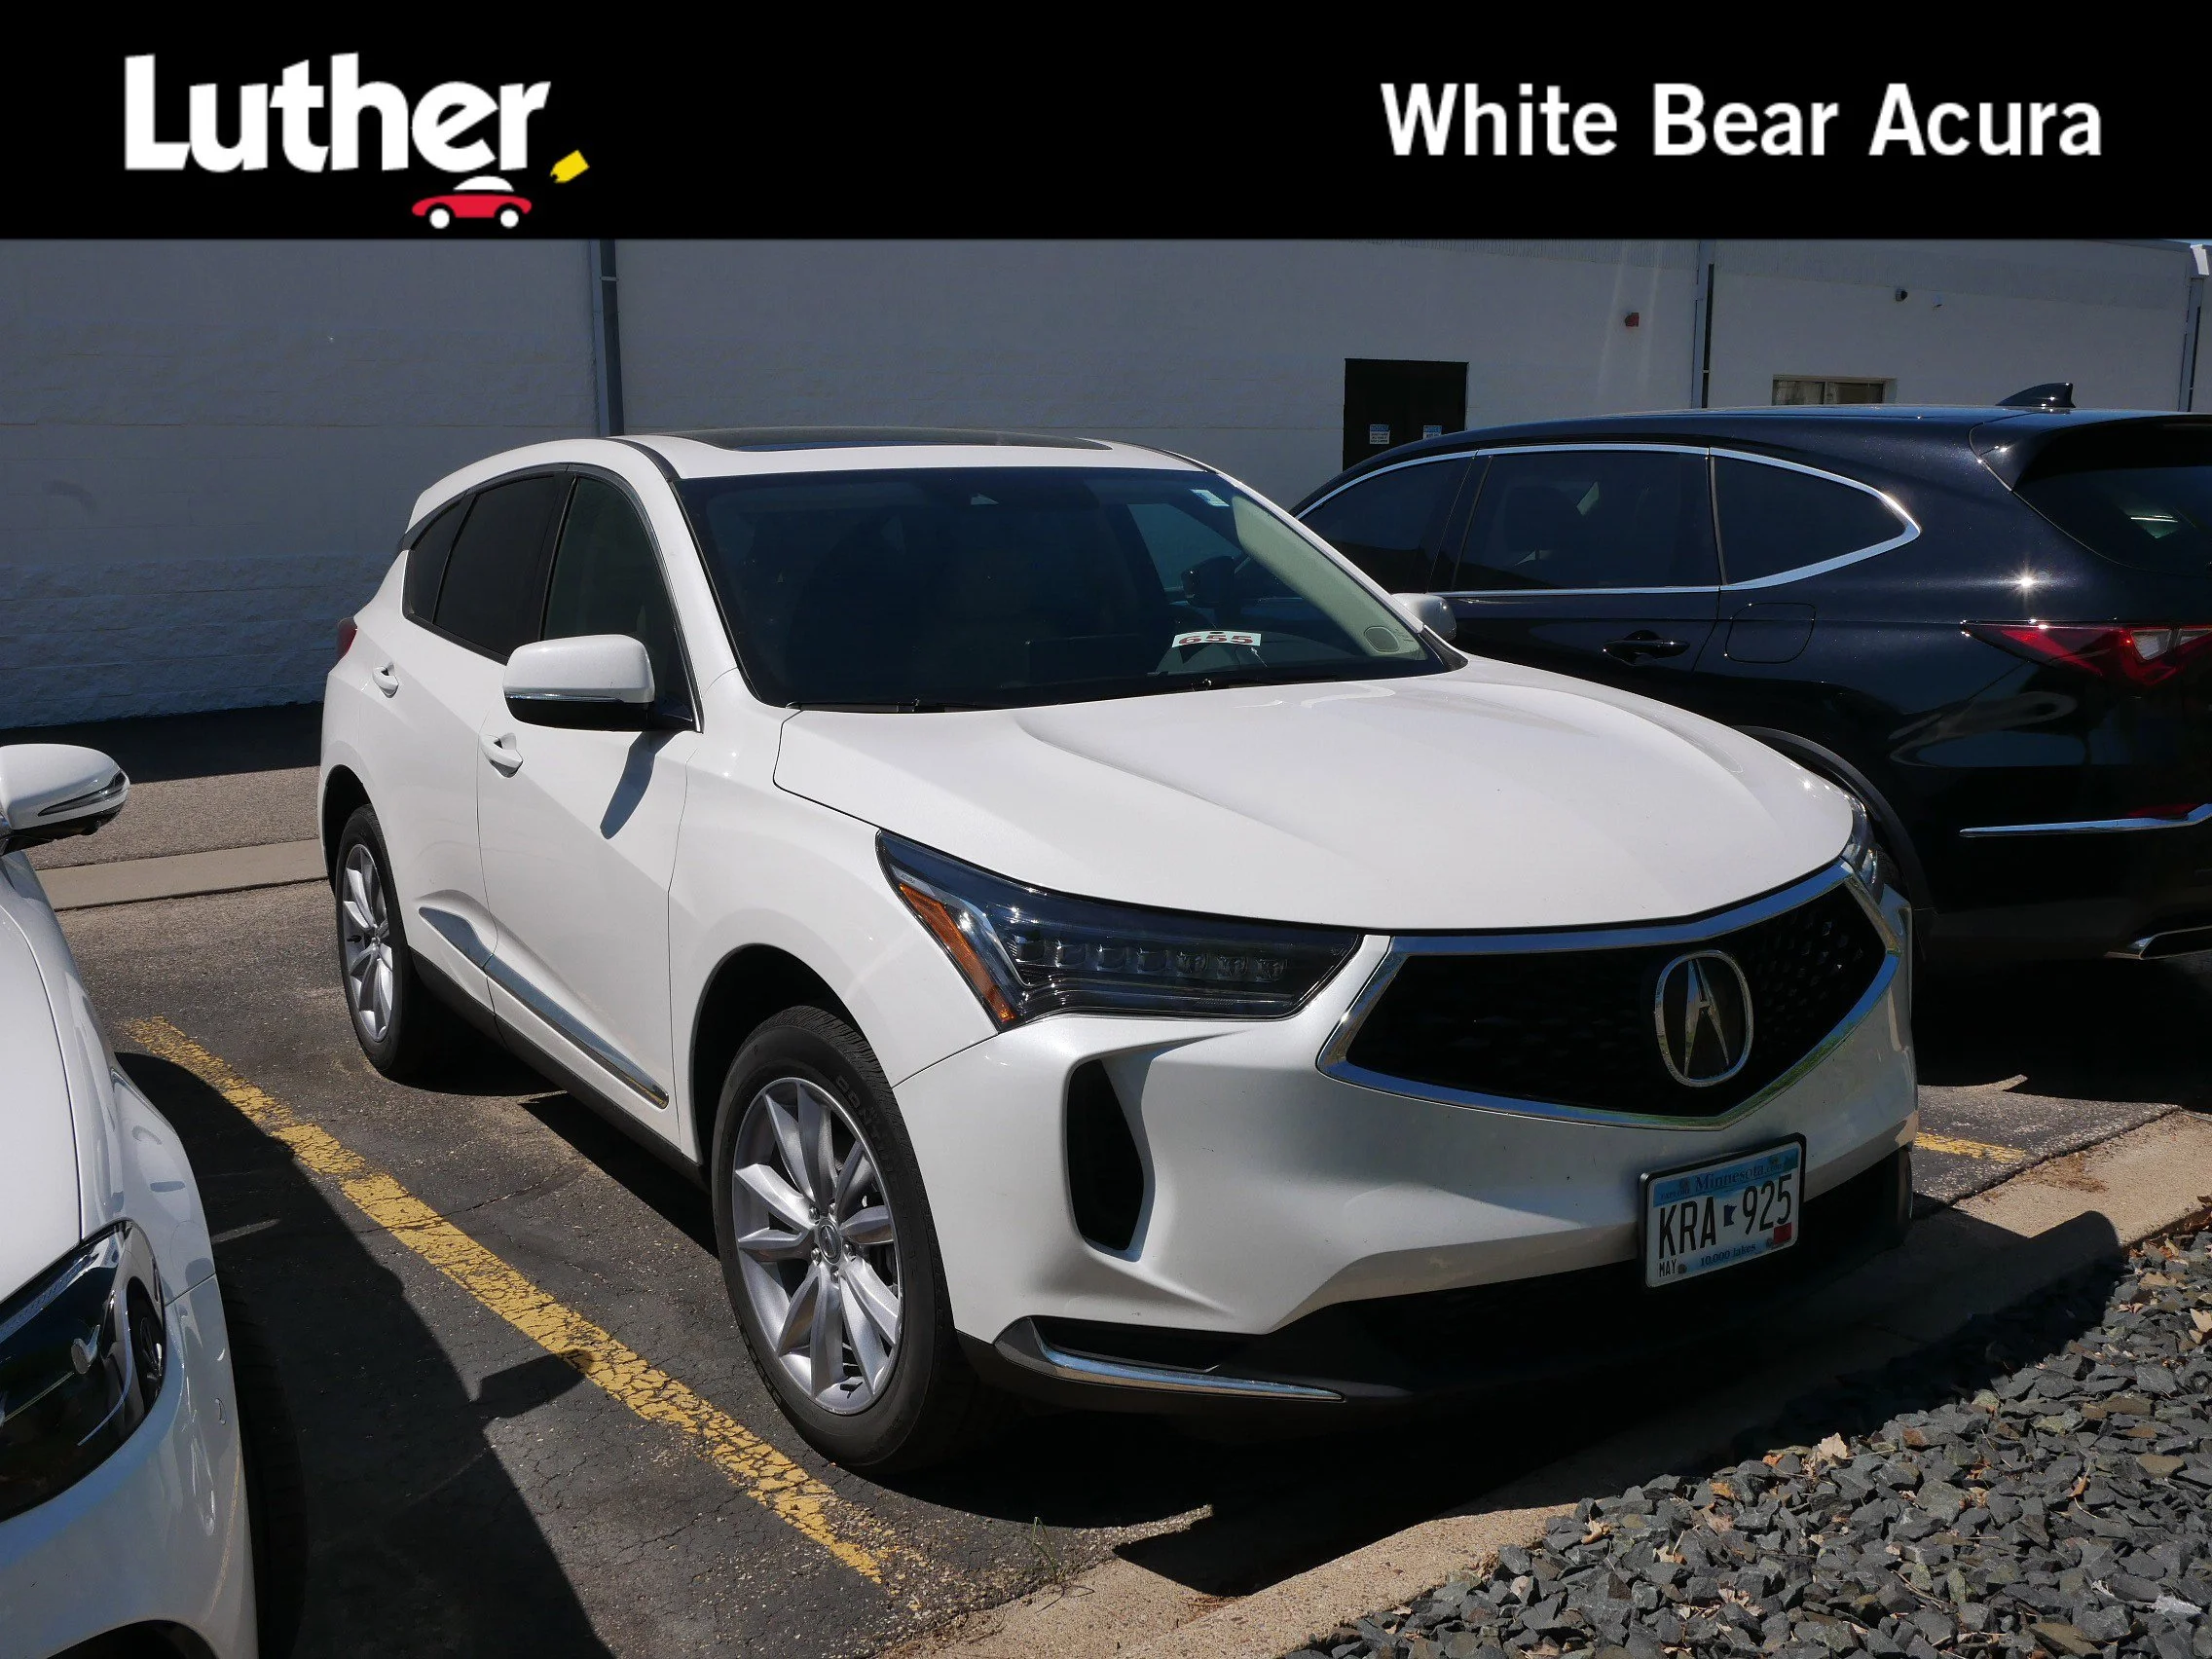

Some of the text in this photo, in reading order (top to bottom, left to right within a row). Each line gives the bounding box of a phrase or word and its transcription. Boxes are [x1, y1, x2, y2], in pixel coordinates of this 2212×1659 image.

[1178, 635, 1253, 645] 655
[1659, 1174, 1791, 1259] KRA 925
[1732, 1243, 1755, 1258] lakes
[1659, 1259, 1677, 1277] MAY
